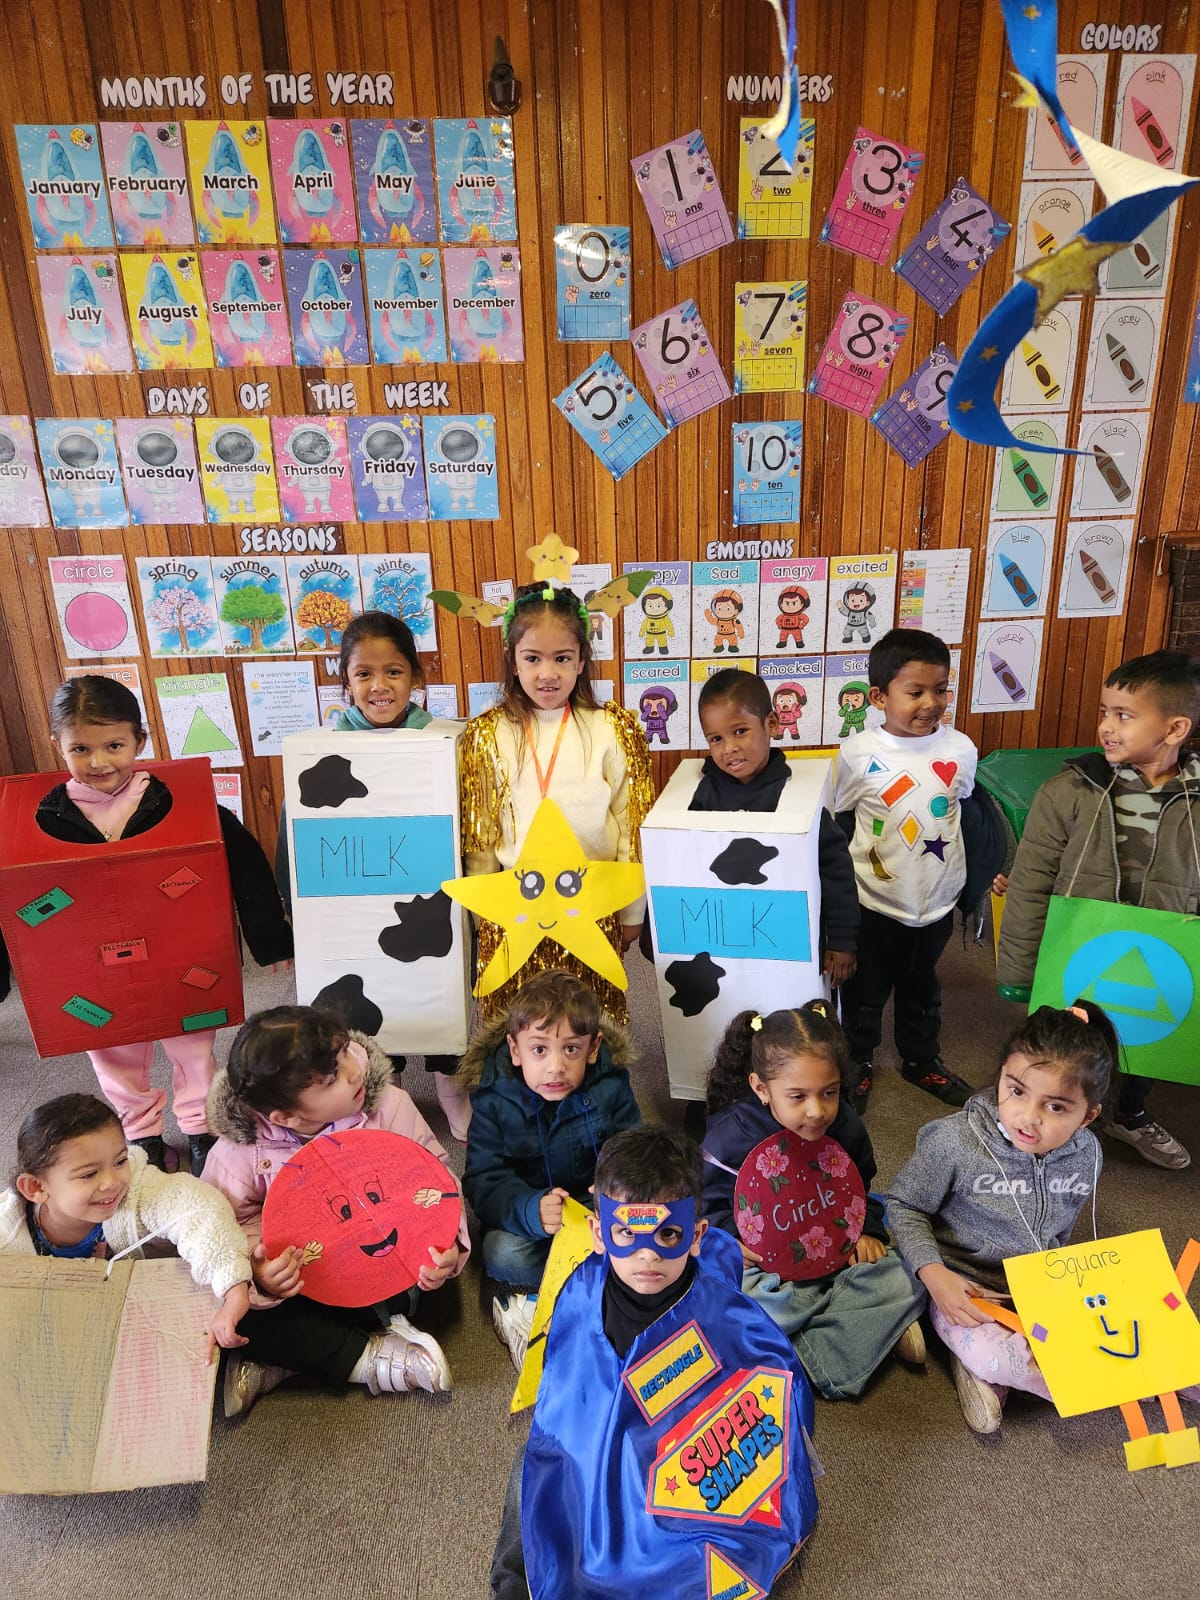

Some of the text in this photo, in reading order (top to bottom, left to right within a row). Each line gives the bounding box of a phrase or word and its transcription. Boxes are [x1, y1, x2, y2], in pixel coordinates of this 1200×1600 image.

[1081, 23, 1161, 51] COLORS
[1059, 69, 1078, 80] red
[1146, 72, 1166, 81] pink
[101, 72, 394, 108] MONTHS OF THE YEAR
[727, 74, 833, 102] NUMERS
[665, 149, 683, 201] 1
[863, 145, 902, 194] 3
[29, 179, 101, 198] January
[109, 177, 186, 194] February
[204, 175, 258, 190] March
[294, 174, 333, 192] April
[377, 175, 412, 192] May
[455, 174, 496, 188] June
[773, 186, 792, 195] two
[684, 201, 704, 215] one
[862, 202, 887, 218] three
[1038, 198, 1071, 211] orange
[951, 209, 987, 248] 4
[576, 231, 610, 282] 0
[941, 252, 960, 270] four
[590, 290, 611, 299] zero
[212, 300, 281, 314] September
[301, 299, 351, 312] October
[374, 298, 438, 310] November
[453, 297, 515, 309] December
[68, 306, 101, 322] July
[138, 305, 198, 322] August
[754, 293, 786, 340] 7
[1118, 315, 1140, 326] grey
[661, 317, 690, 364] 6
[847, 313, 884, 359] 8
[764, 346, 793, 354] seven
[686, 367, 701, 379] six
[850, 364, 873, 379] eight
[148, 381, 450, 414] DAYS OF THE WEEK
[575, 371, 617, 421] 5
[617, 413, 634, 428] five
[916, 413, 932, 431] nine
[1018, 429, 1044, 441] green
[1103, 426, 1128, 436] black
[748, 435, 786, 472] 10
[0, 465, 28, 477] day
[50, 468, 116, 484] Monday
[126, 466, 194, 482] Tuesday
[205, 464, 271, 474] Wednesday
[284, 465, 344, 477] Thursday
[365, 460, 415, 477] Friday
[430, 462, 494, 475] Saturday
[768, 480, 782, 489] ten
[240, 526, 337, 553] SEASONS
[1011, 533, 1030, 541] blue
[1084, 533, 1114, 544] brown
[706, 539, 794, 560] EMOTIONS
[63, 564, 115, 580] circle
[148, 559, 198, 582] spring
[220, 560, 278, 582] summer
[299, 559, 350, 580] autumn
[374, 557, 418, 575] winter
[711, 567, 739, 579] Sad
[773, 564, 816, 581] angry
[837, 562, 888, 574] excited
[632, 567, 681, 584] ppy
[996, 632, 1024, 645] purple
[632, 666, 680, 678] scared
[707, 663, 739, 676] tir
[762, 662, 819, 675] shocked
[162, 677, 220, 692] triangle
[321, 834, 408, 878] MILK
[681, 898, 777, 948] MILK
[627, 1208, 657, 1217] SUPER
[773, 1183, 836, 1231] Circle
[1045, 1250, 1121, 1288] Square
[639, 1344, 703, 1401] RECTANGLE
[680, 1391, 768, 1486] SUPER
[699, 1415, 783, 1511] SHAPES
